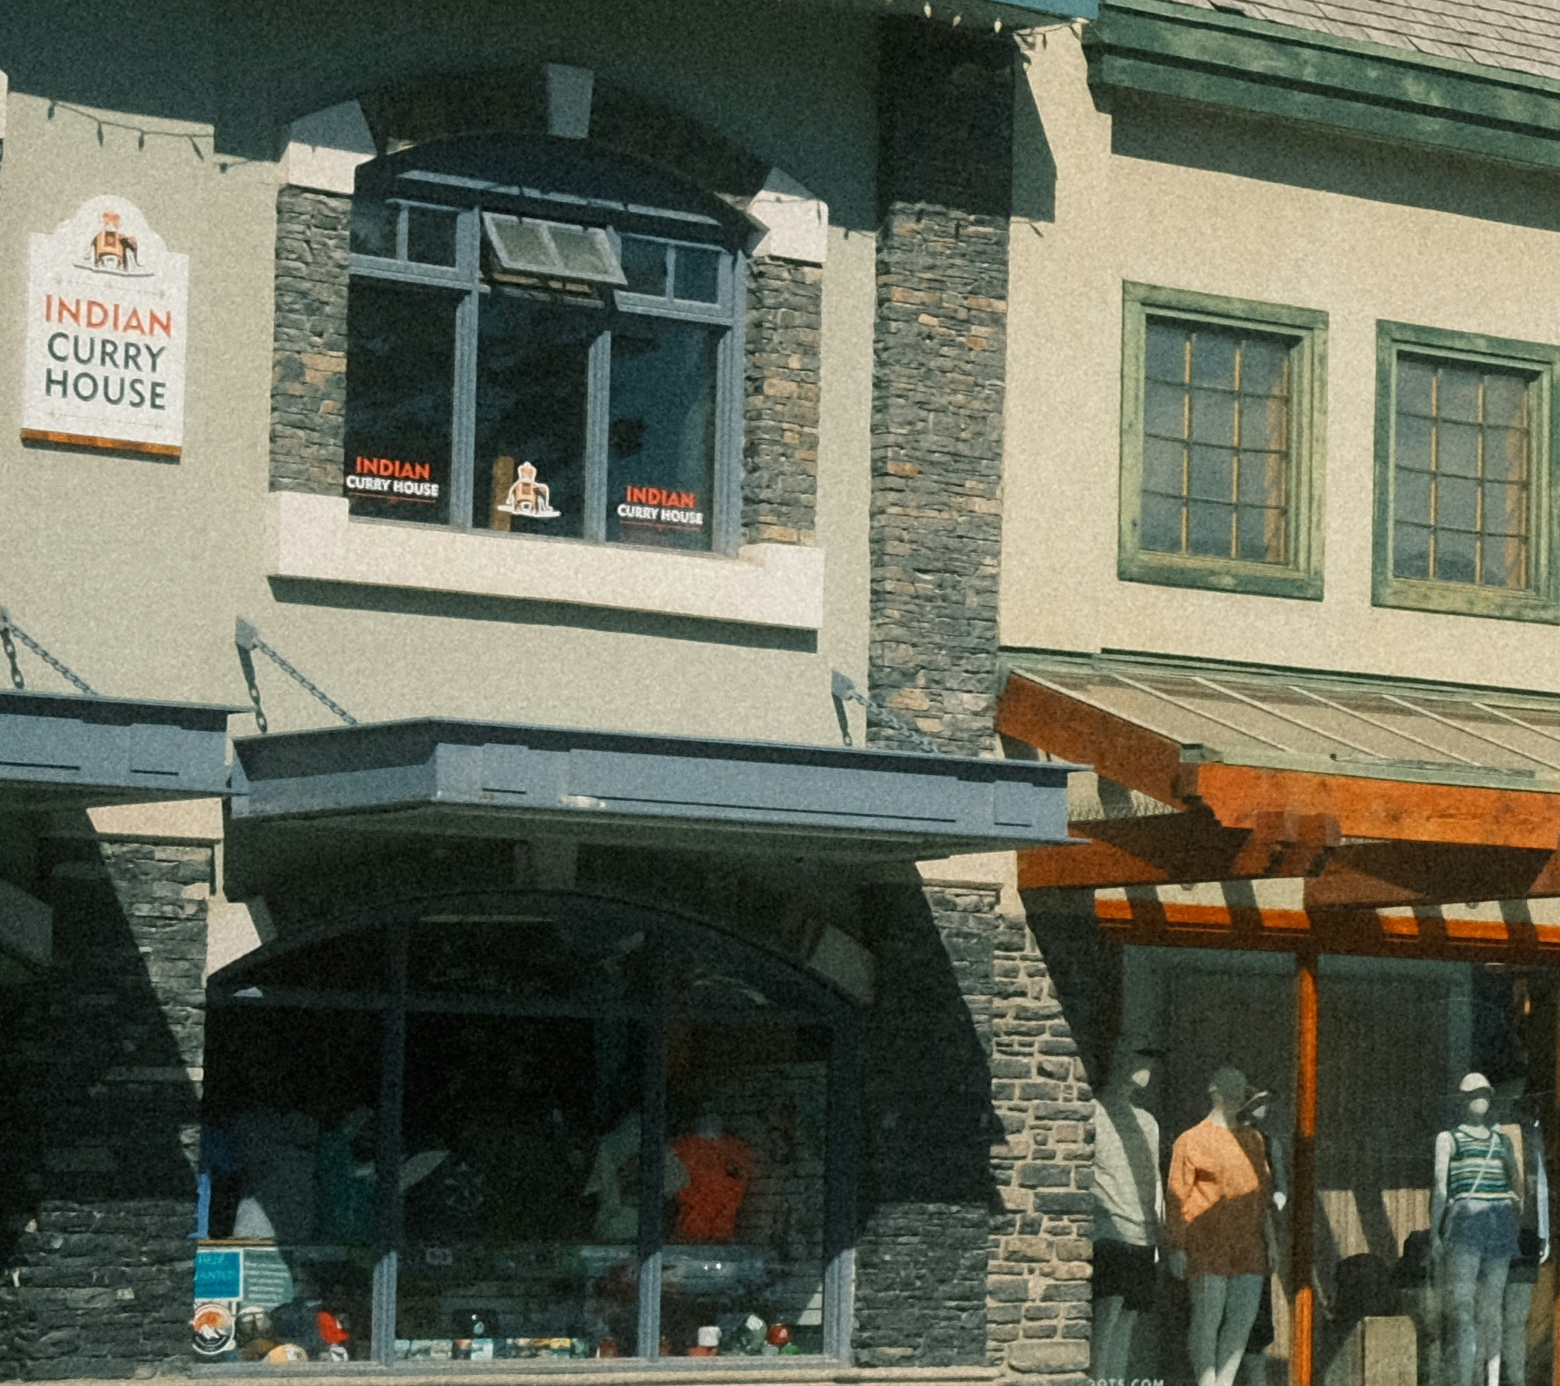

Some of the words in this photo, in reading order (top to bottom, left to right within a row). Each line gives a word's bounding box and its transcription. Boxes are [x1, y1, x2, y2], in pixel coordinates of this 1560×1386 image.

[45, 294, 172, 339] INDIAN
[47, 331, 166, 373] CURRY
[45, 367, 166, 410] HOUSE
[356, 456, 430, 480] INDIAN
[346, 475, 391, 491] CURRY
[393, 479, 439, 498] HOUSE
[626, 485, 696, 509] INDIAN
[617, 504, 659, 520] CURRY
[661, 508, 704, 525] HOUSE
